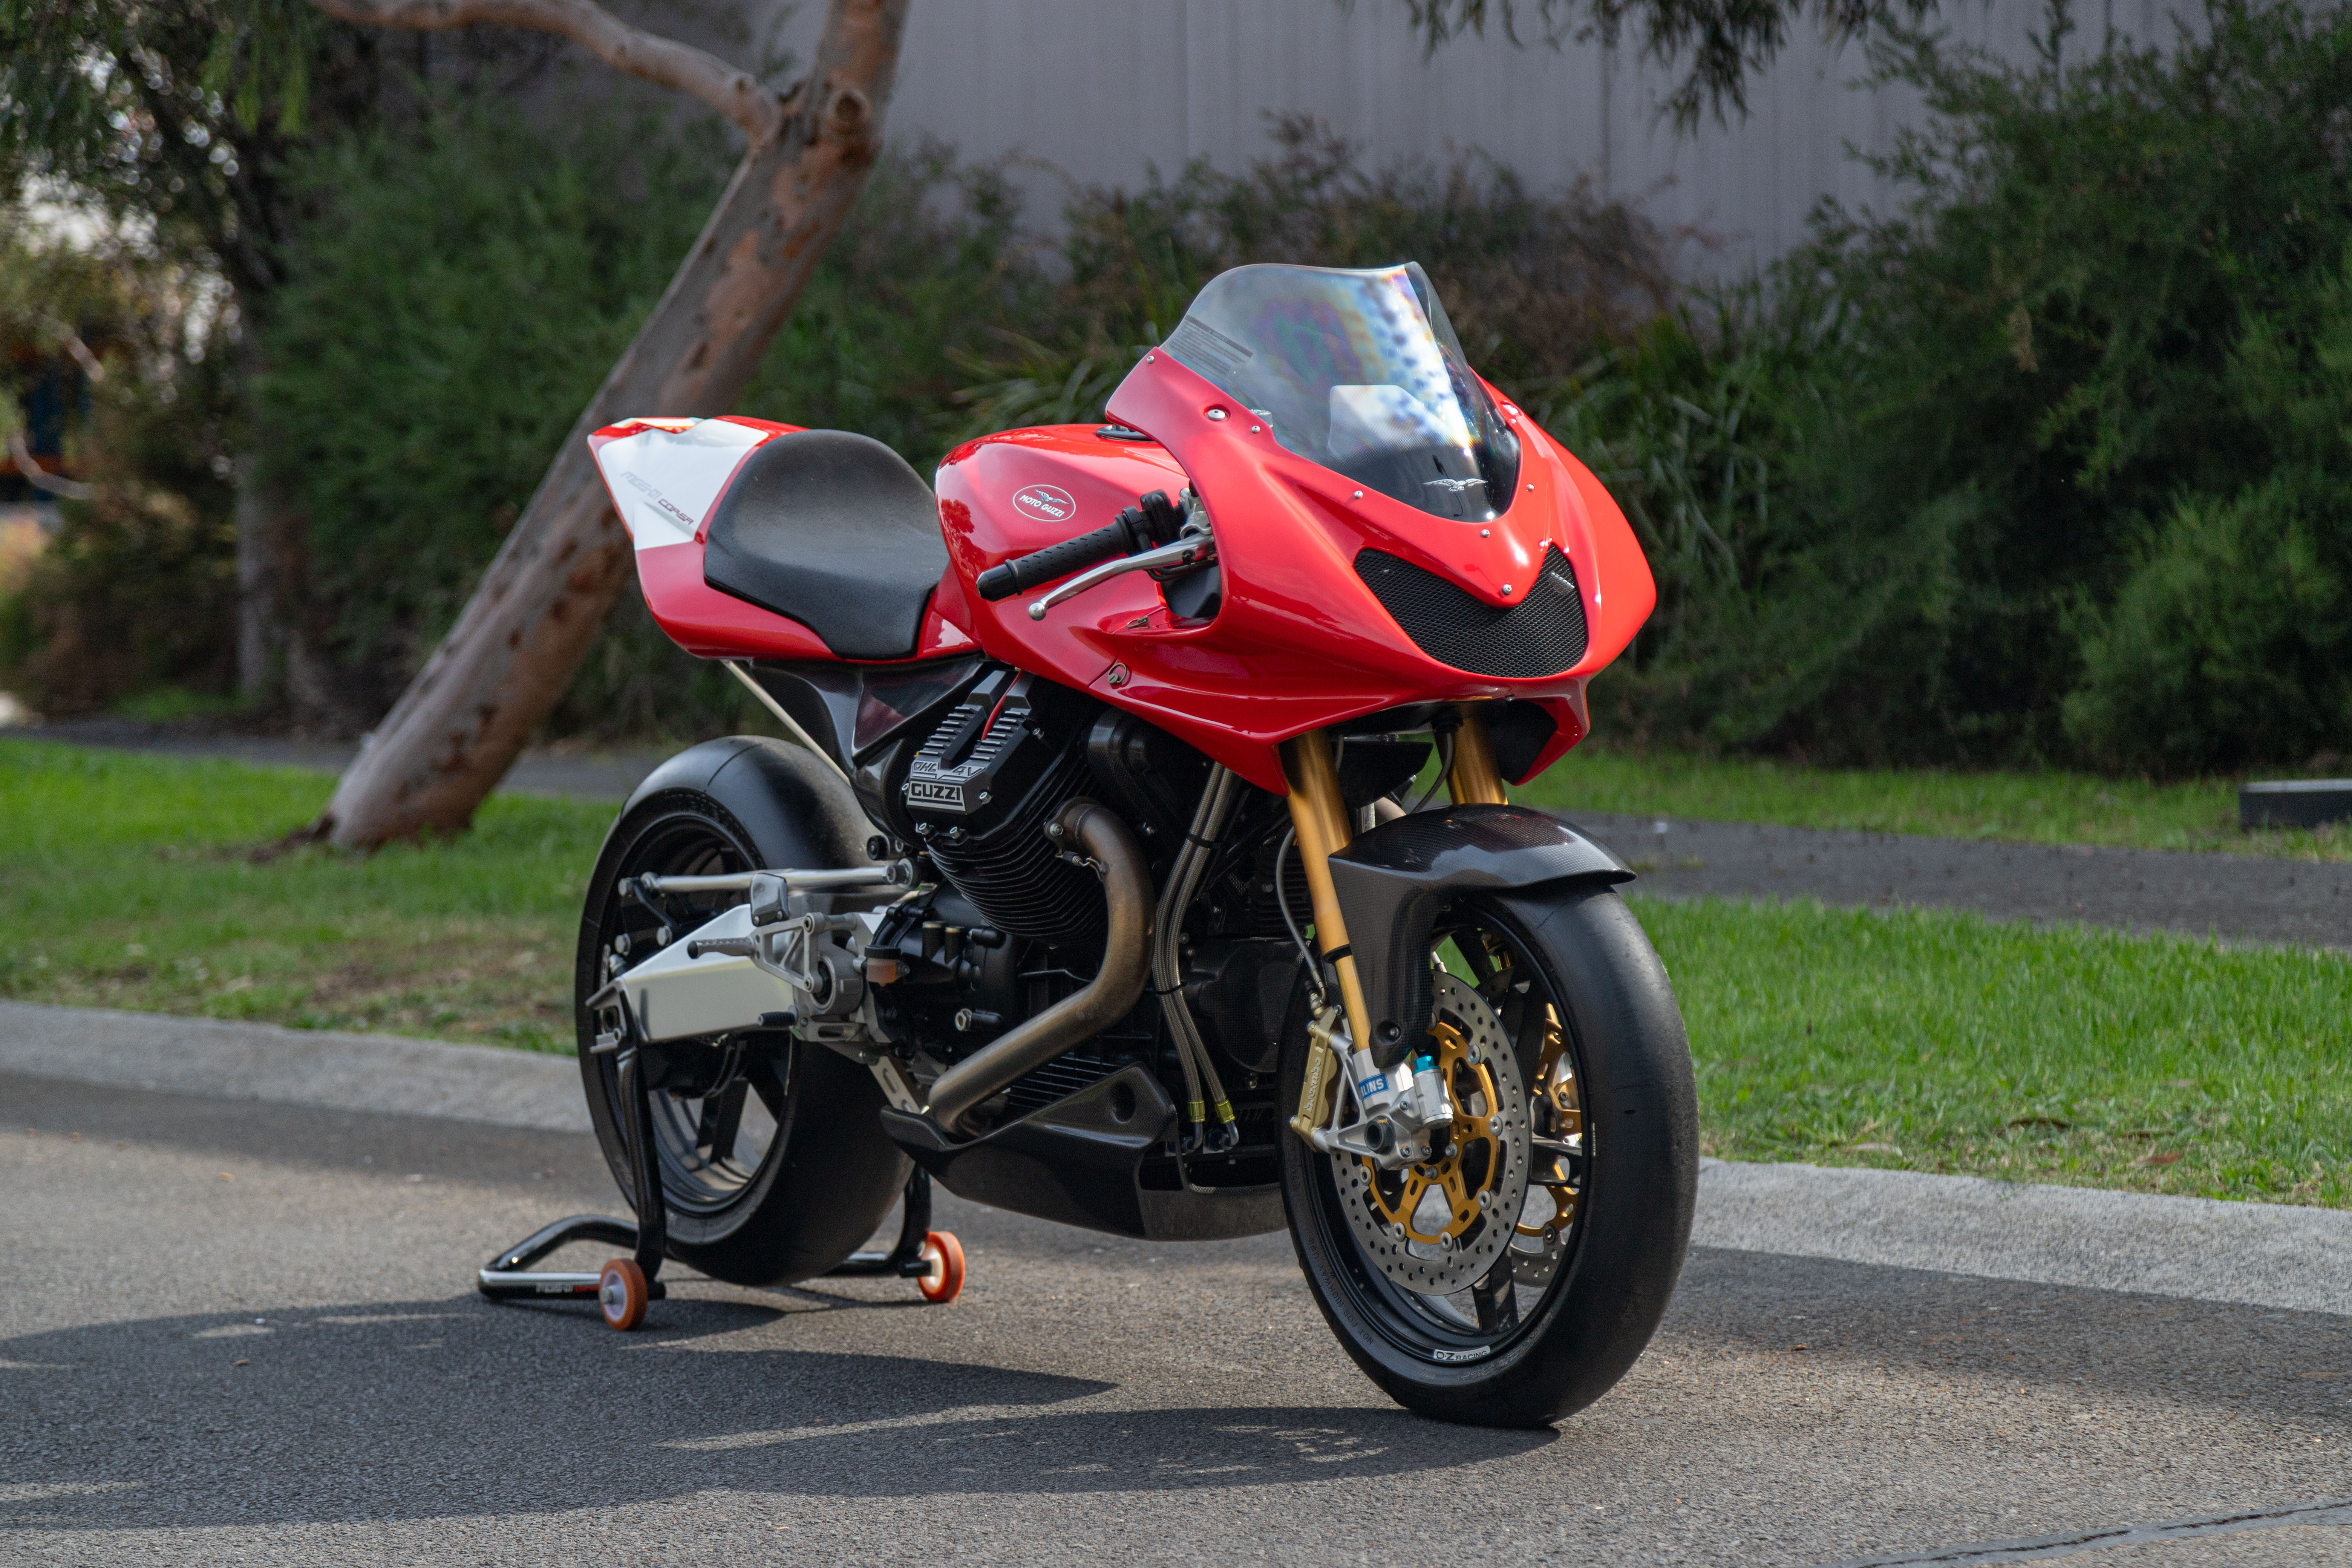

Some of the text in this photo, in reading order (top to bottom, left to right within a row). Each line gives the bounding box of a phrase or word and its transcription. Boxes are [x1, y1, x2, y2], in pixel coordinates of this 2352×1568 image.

[658, 498, 694, 525] CORSA
[1019, 494, 1065, 518] MOTO GUZZI
[911, 782, 960, 801] GUZZI
[1304, 1057, 1321, 1112] brembo
[1456, 1351, 1487, 1360] RACING
